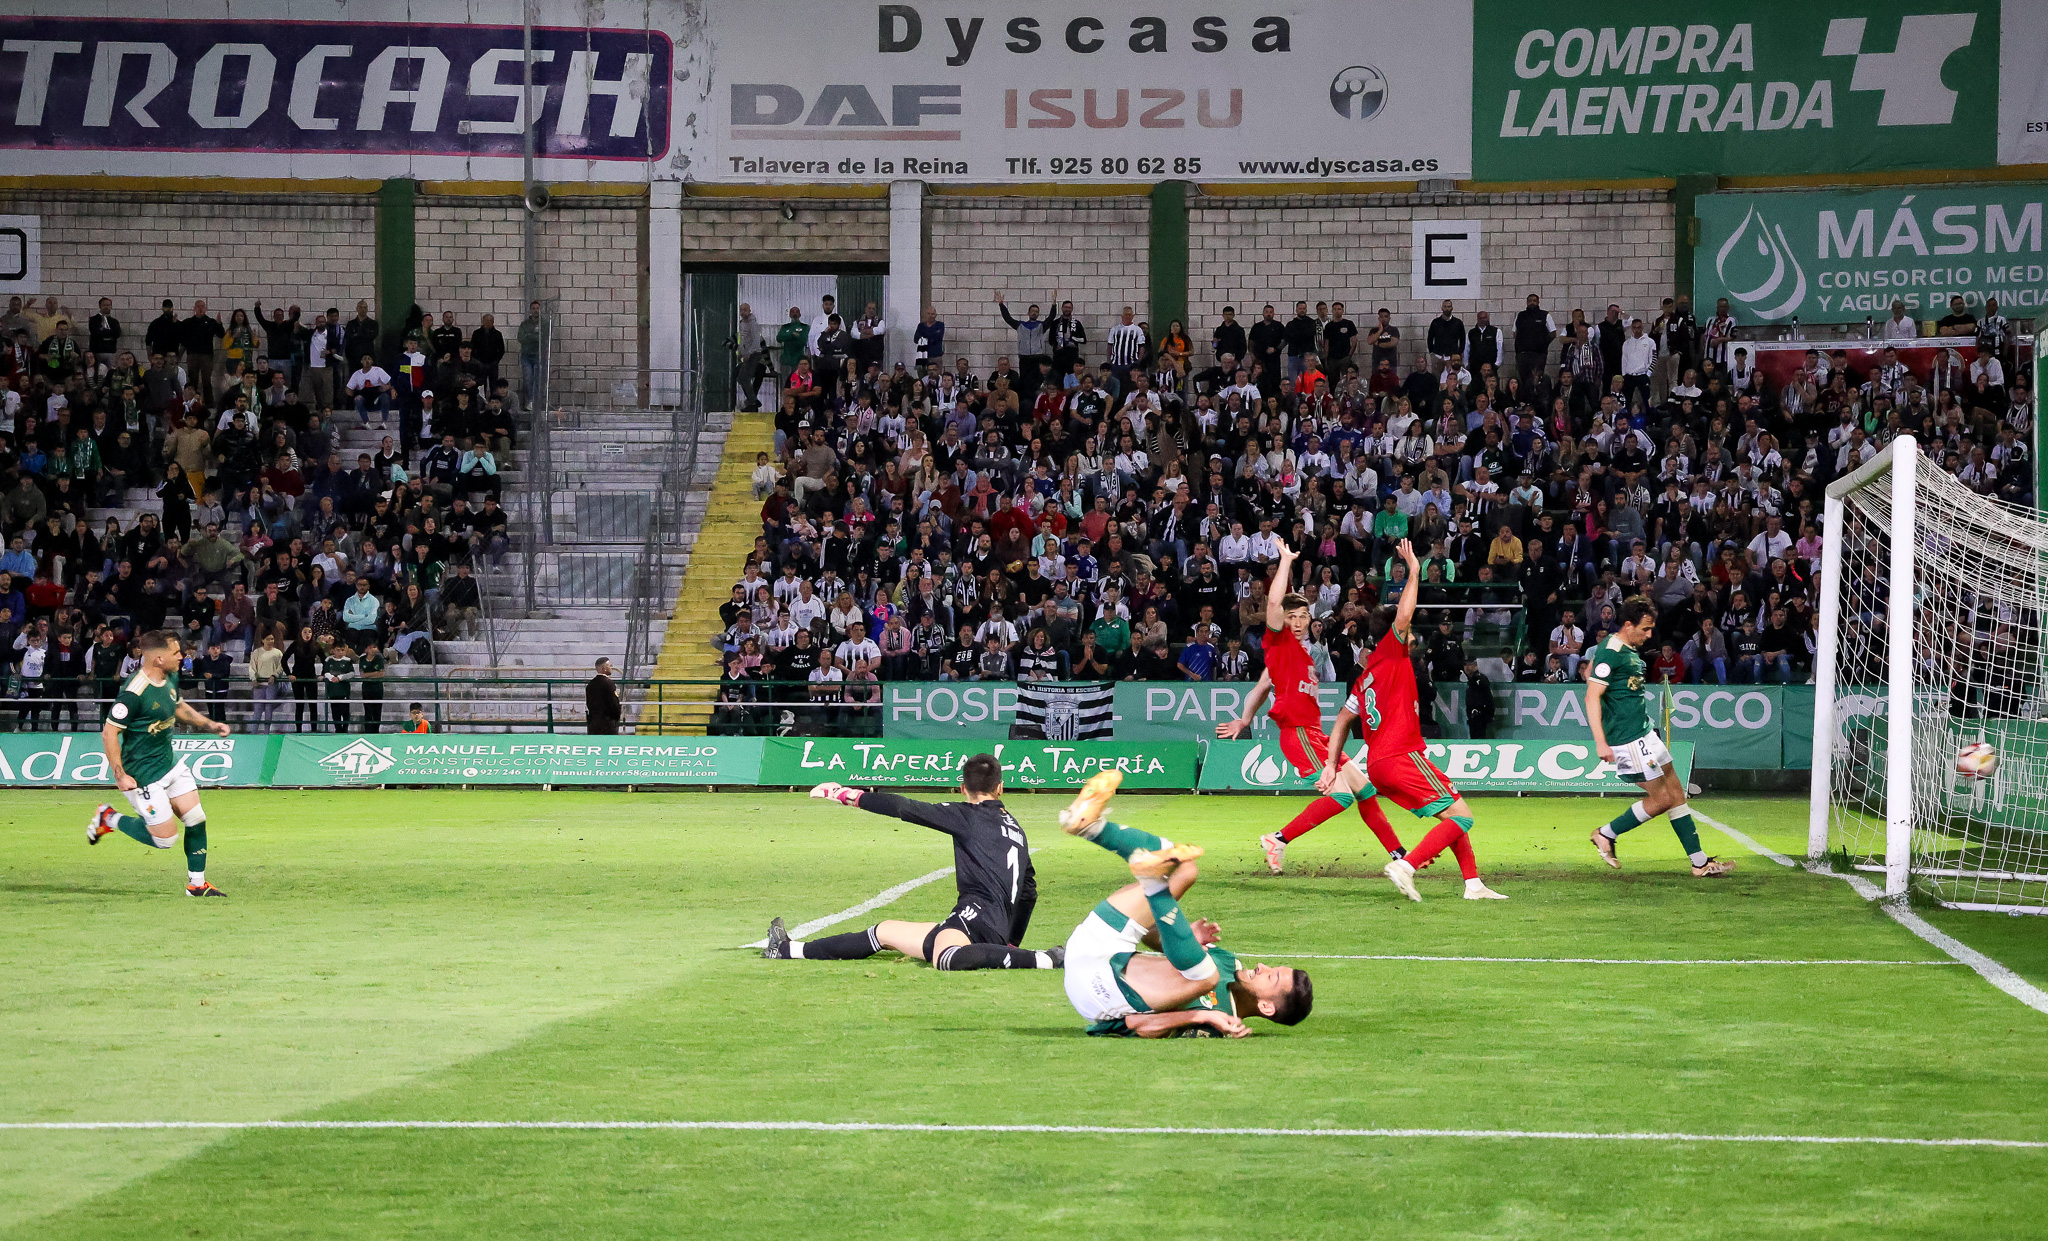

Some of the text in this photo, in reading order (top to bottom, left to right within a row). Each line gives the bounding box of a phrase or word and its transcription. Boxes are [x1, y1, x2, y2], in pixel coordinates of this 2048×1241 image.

[878, 4, 1292, 66] Dyscasa
[1514, 23, 1754, 79] COMPRA
[2, 39, 654, 138] TROCASH
[730, 84, 961, 126] DAF
[1005, 88, 1244, 130] ISUZU
[1500, 79, 1834, 138] LAENTRADA
[729, 156, 968, 175] Talavera de la Reina
[1005, 157, 1201, 175] Tlf. 925 80 62 85
[1238, 156, 1440, 178] www.dyscasa.es
[1425, 233, 1468, 286] E
[1818, 268, 1973, 289] CONSORCIO
[1817, 295, 1833, 312] Y
[1839, 292, 1920, 312] AGUAS
[405, 744, 718, 757] MANUEL FERRER BERMEJO
[397, 768, 417, 776] 670
[419, 768, 440, 776] 634
[403, 757, 717, 768] CONSTRUCCIONES EN GENERAL
[479, 768, 500, 776] 927
[501, 768, 522, 776] 246
[1007, 845, 1020, 905] 1
